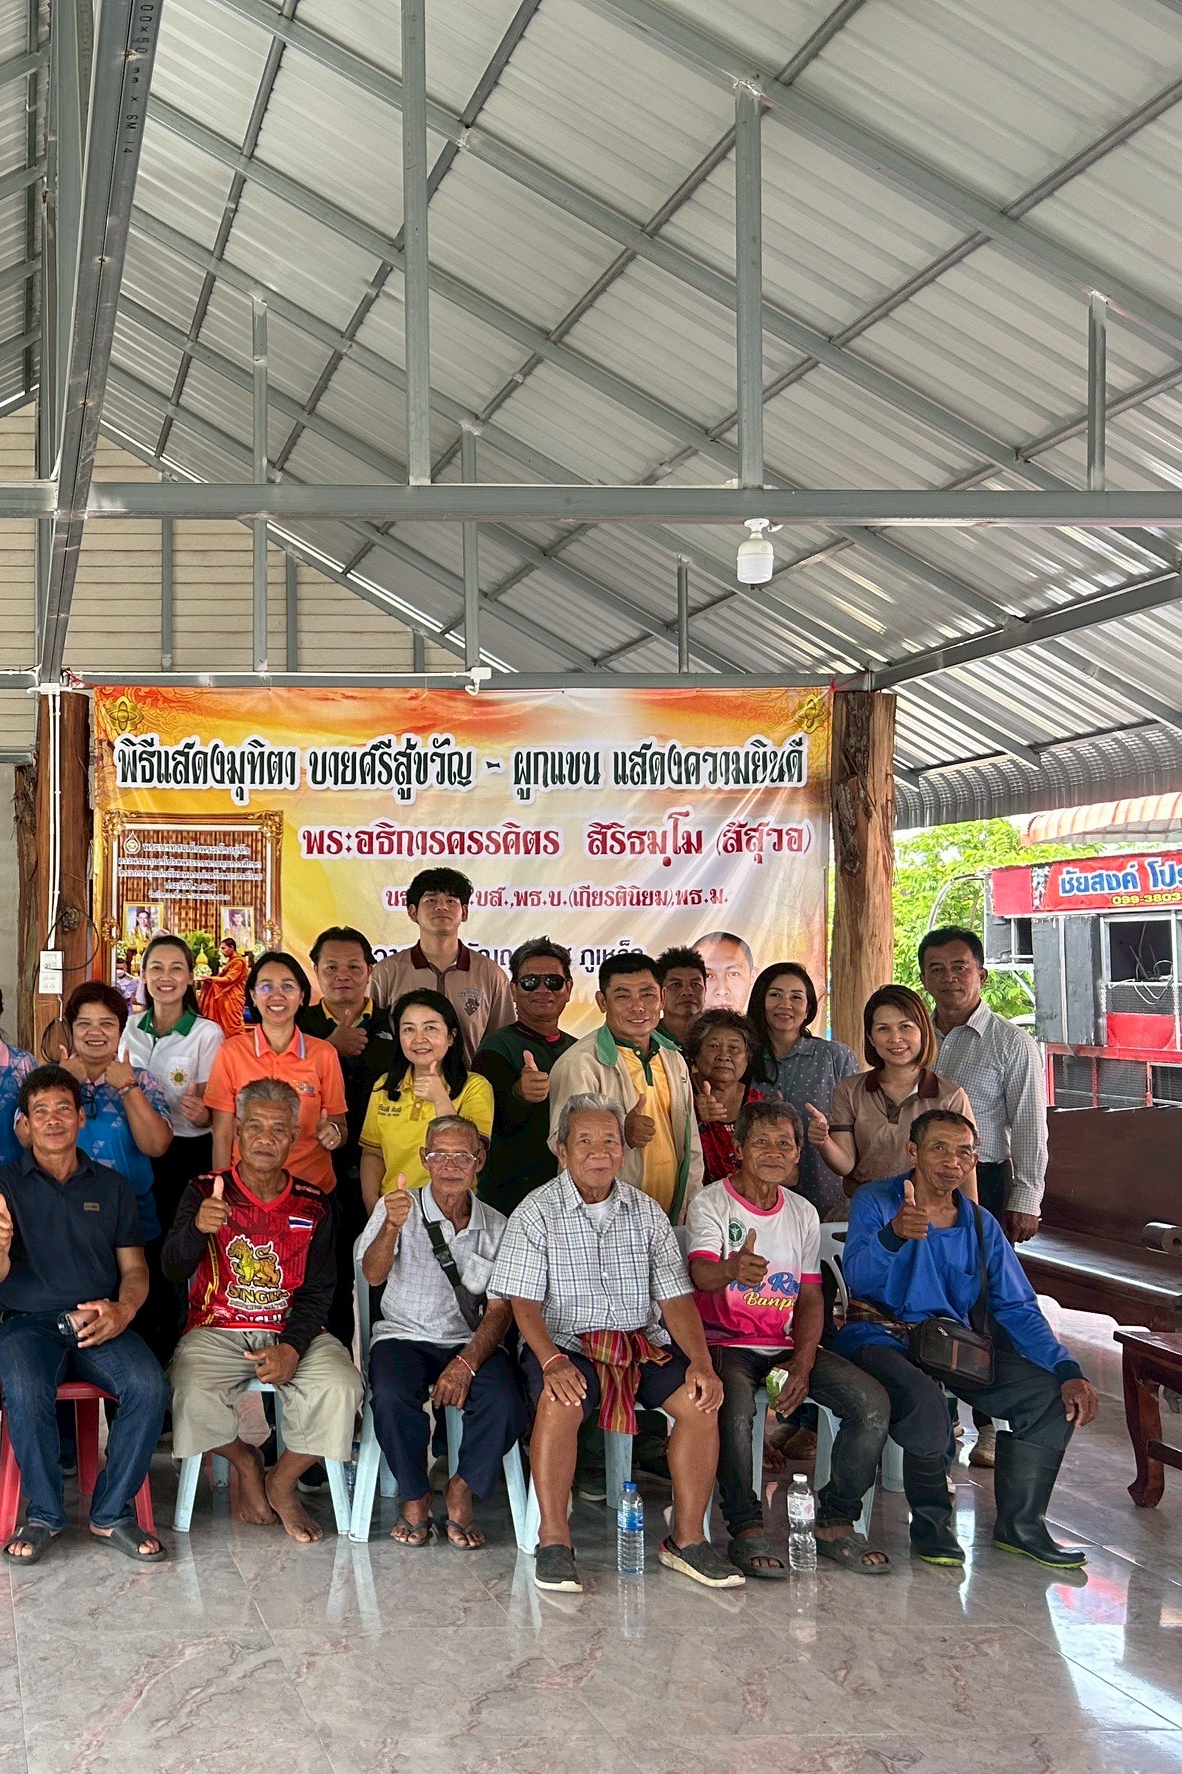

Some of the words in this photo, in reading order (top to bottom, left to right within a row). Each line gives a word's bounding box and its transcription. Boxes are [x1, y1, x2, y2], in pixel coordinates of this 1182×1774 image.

[117, 738, 297, 801] พิธีแสดงมุทิตา
[309, 737, 473, 801] บายศรีสู่ขวัญ
[513, 750, 601, 801] ผูกแขน
[613, 737, 805, 785] แสดงความยินดี
[1060, 863, 1139, 895] ชัยสงค์
[1112, 893, 1182, 906] 099-3803
